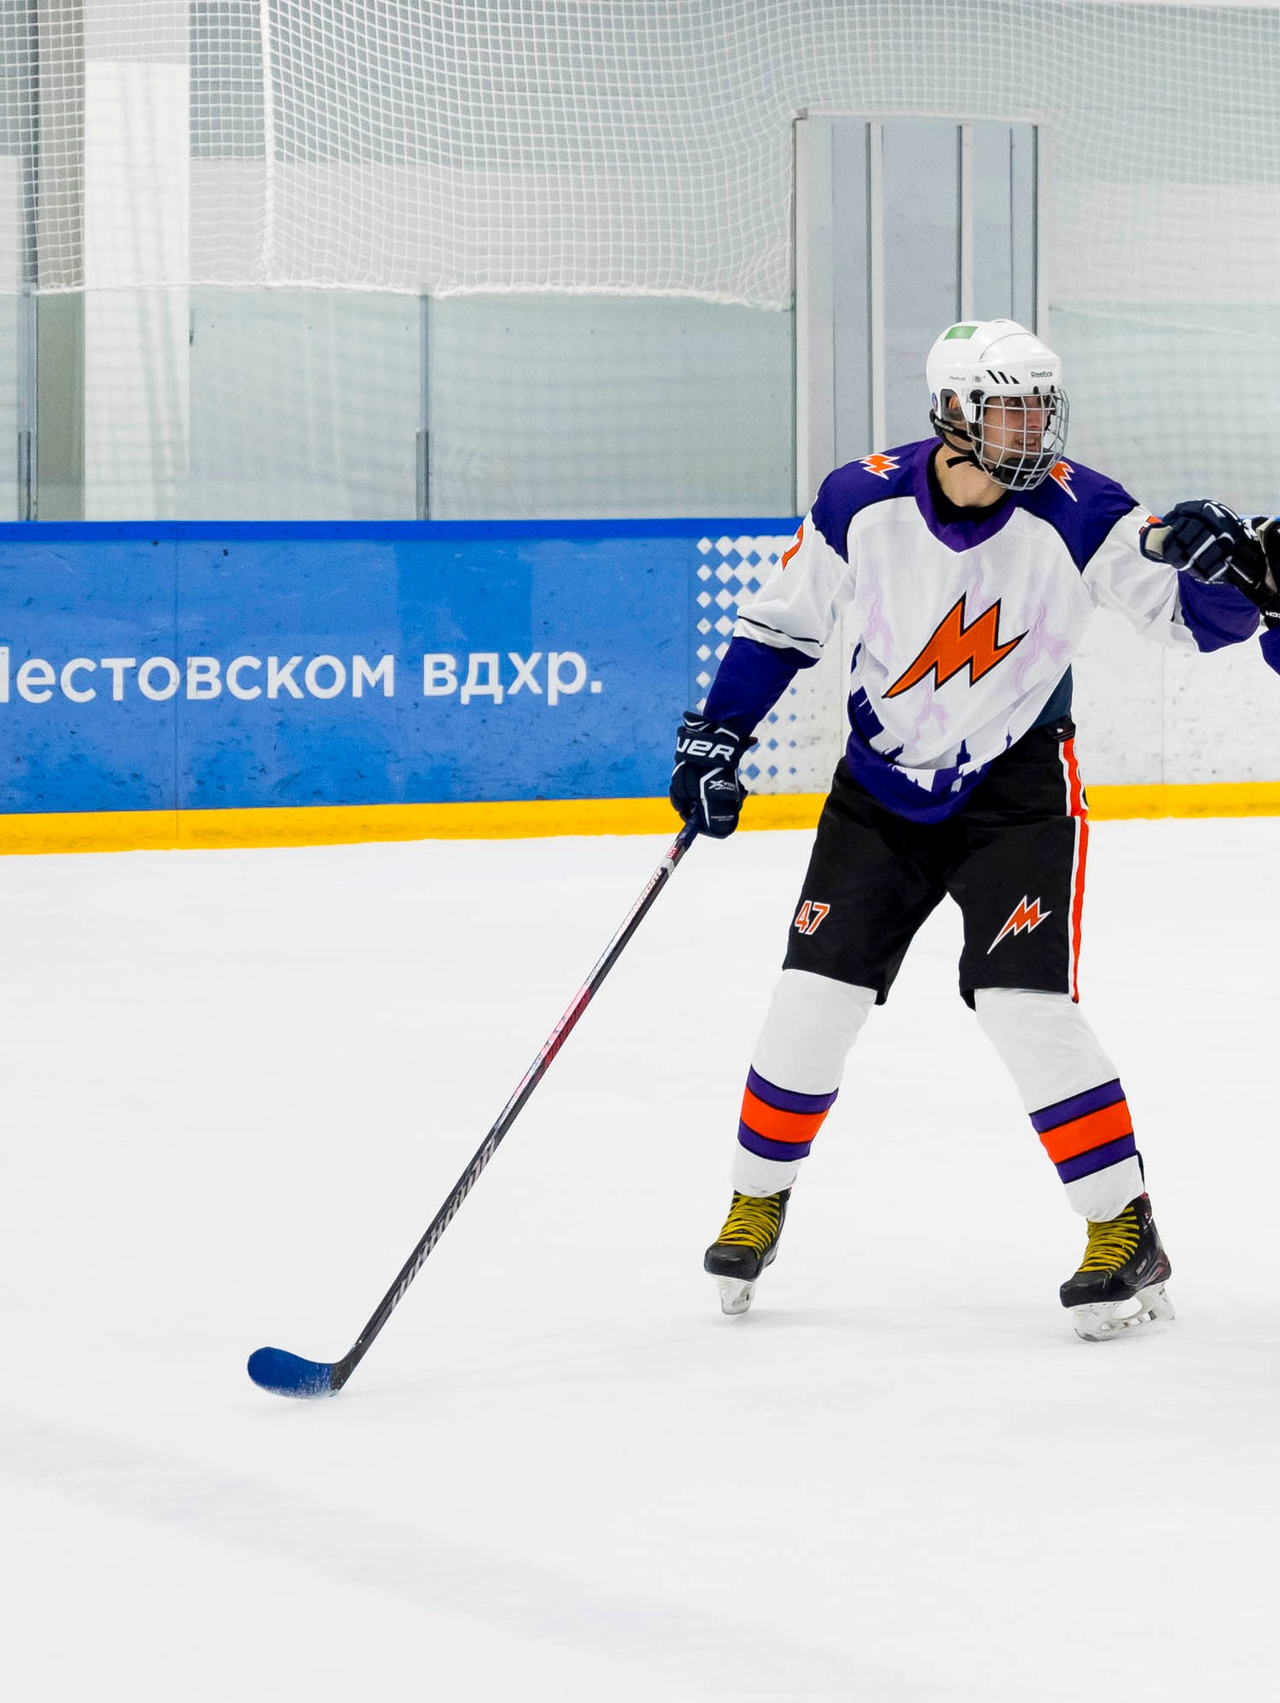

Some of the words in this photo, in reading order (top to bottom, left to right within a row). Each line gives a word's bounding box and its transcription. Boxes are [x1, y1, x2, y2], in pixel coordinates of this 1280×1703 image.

[0, 646, 394, 705] естовском
[422, 651, 602, 706] вдхр.
[794, 899, 830, 936] 47
